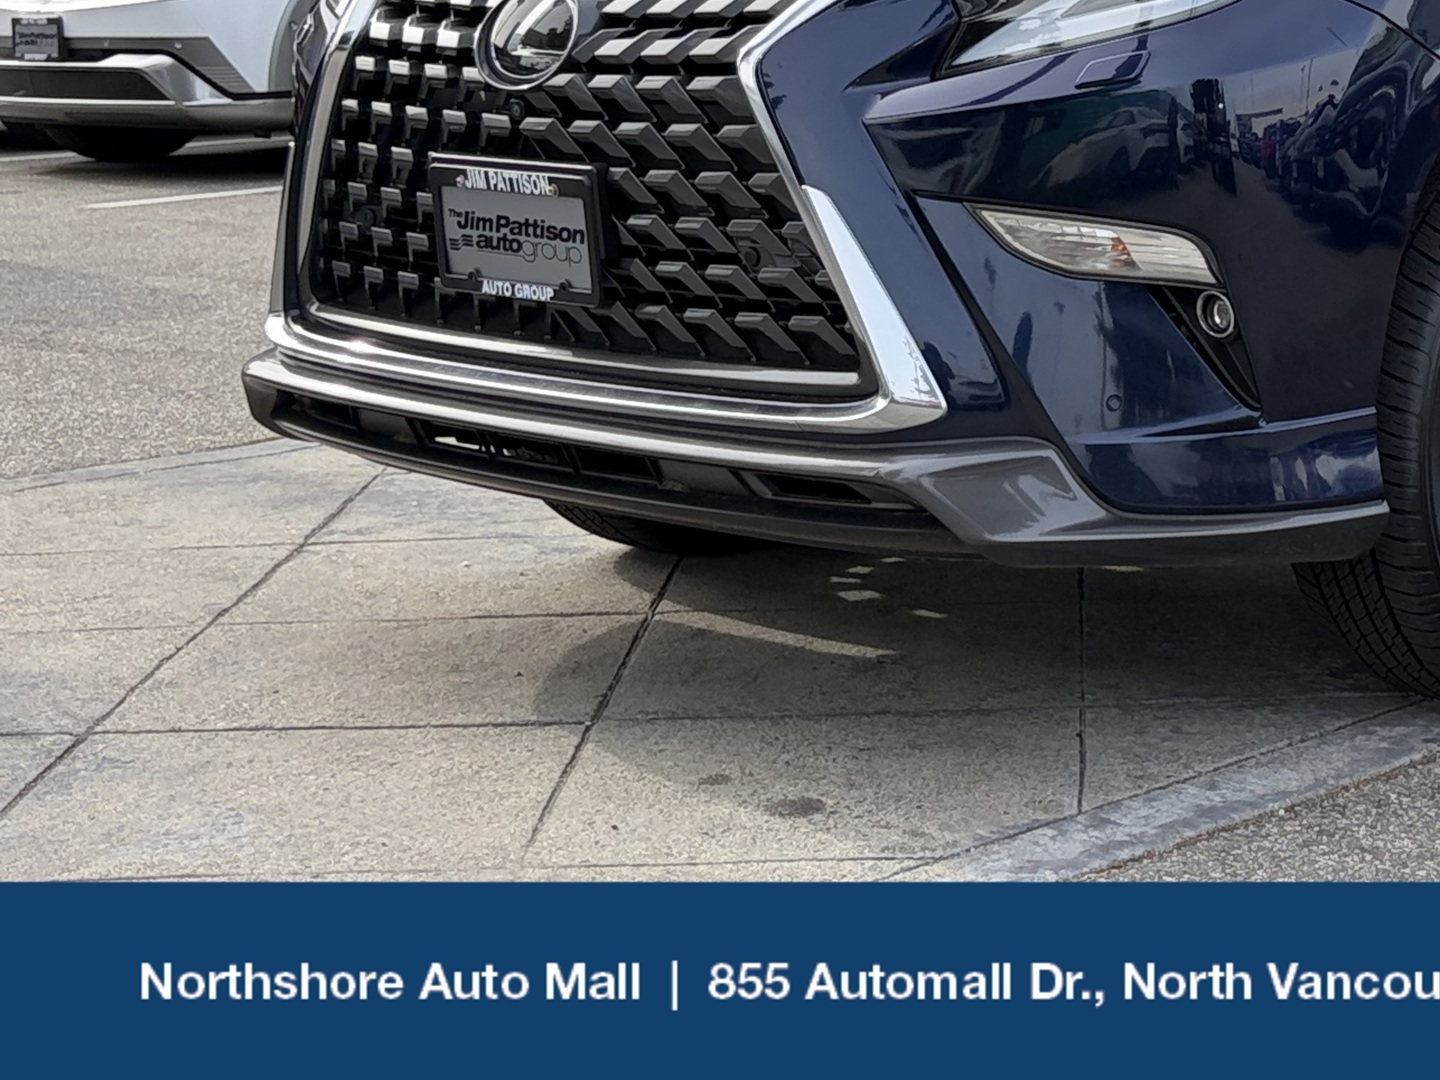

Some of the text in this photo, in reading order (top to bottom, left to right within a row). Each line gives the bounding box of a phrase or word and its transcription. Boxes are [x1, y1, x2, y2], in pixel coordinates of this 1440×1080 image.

[465, 169, 550, 196] JIM PATTISON
[447, 208, 463, 219] The
[482, 280, 555, 301] AUTO GROUP
